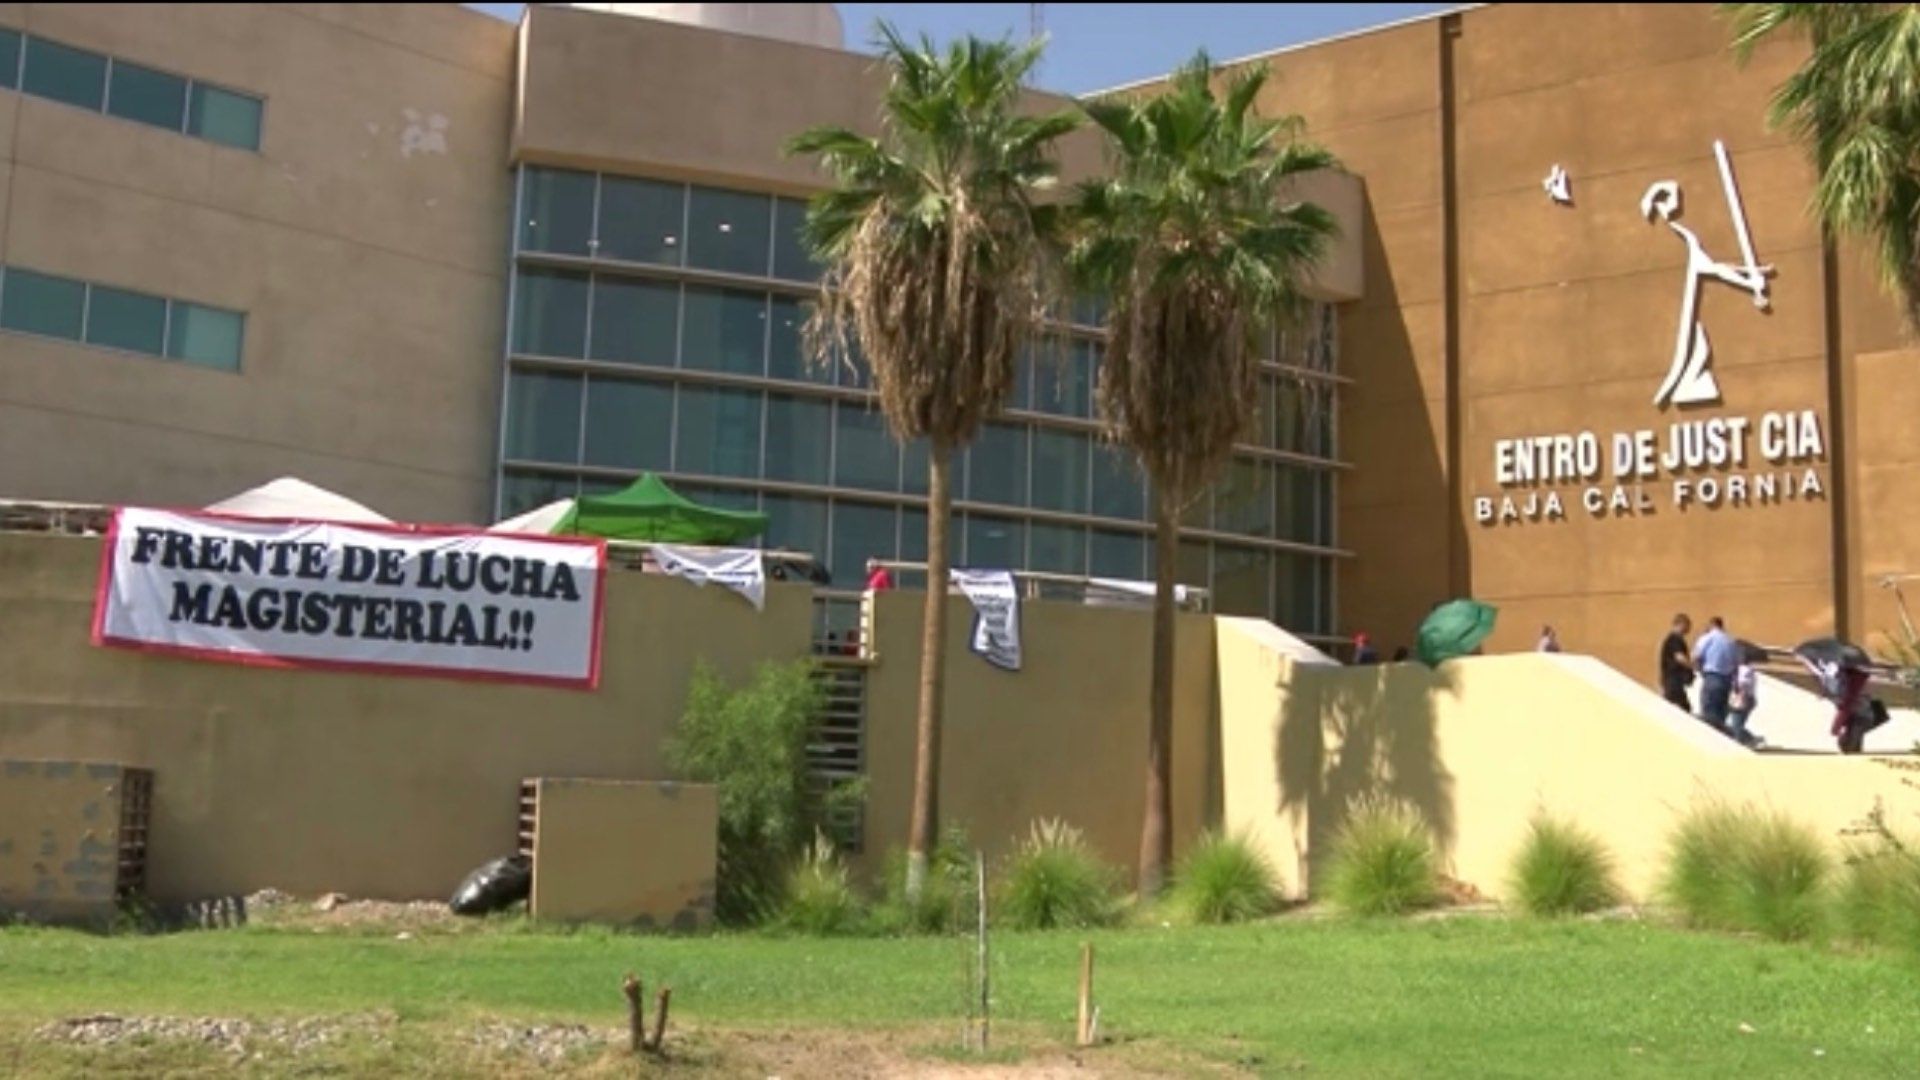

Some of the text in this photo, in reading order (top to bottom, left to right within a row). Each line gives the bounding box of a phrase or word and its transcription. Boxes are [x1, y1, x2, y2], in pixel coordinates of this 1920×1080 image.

[1495, 430, 1599, 484] ENTRO
[1612, 430, 1657, 478] DE
[1474, 491, 1564, 522] BAJA
[130, 525, 581, 601] FRENTE DE LUCHA
[168, 581, 536, 652] MAGISTERIAL!!
